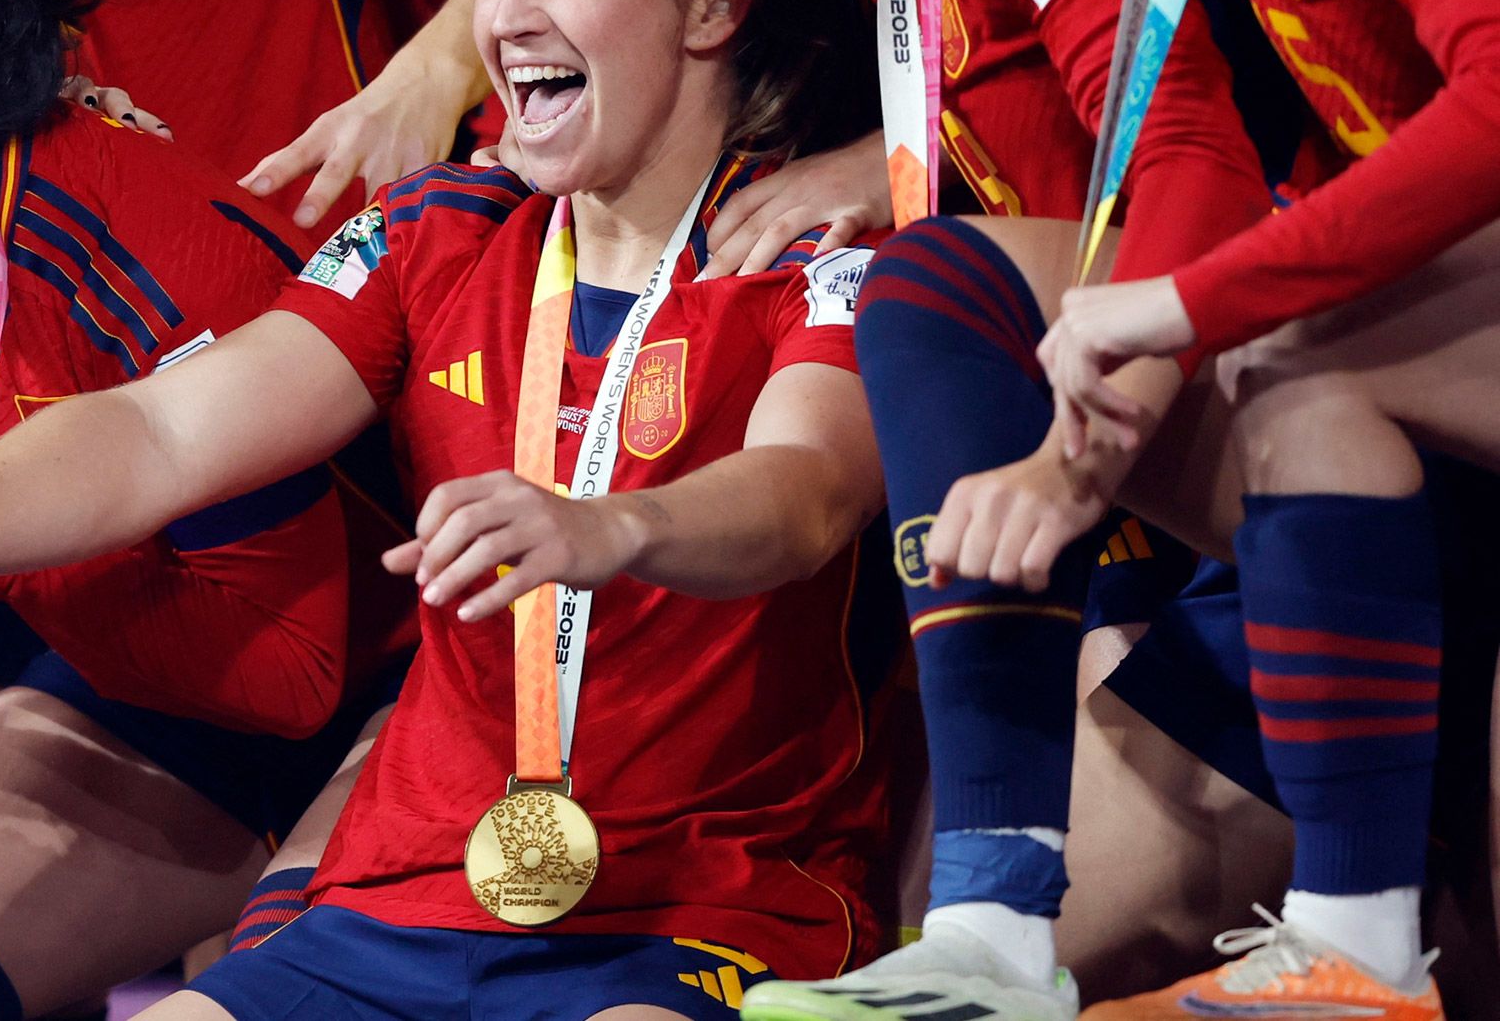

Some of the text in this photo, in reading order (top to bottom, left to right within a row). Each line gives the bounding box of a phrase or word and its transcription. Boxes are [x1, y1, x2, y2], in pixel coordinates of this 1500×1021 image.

[642, 258, 664, 300] FIFA
[609, 302, 651, 399] WOMEN'S
[586, 402, 617, 476] WORLD
[503, 887, 542, 896] WORLD
[503, 898, 559, 907] CHAMPION
